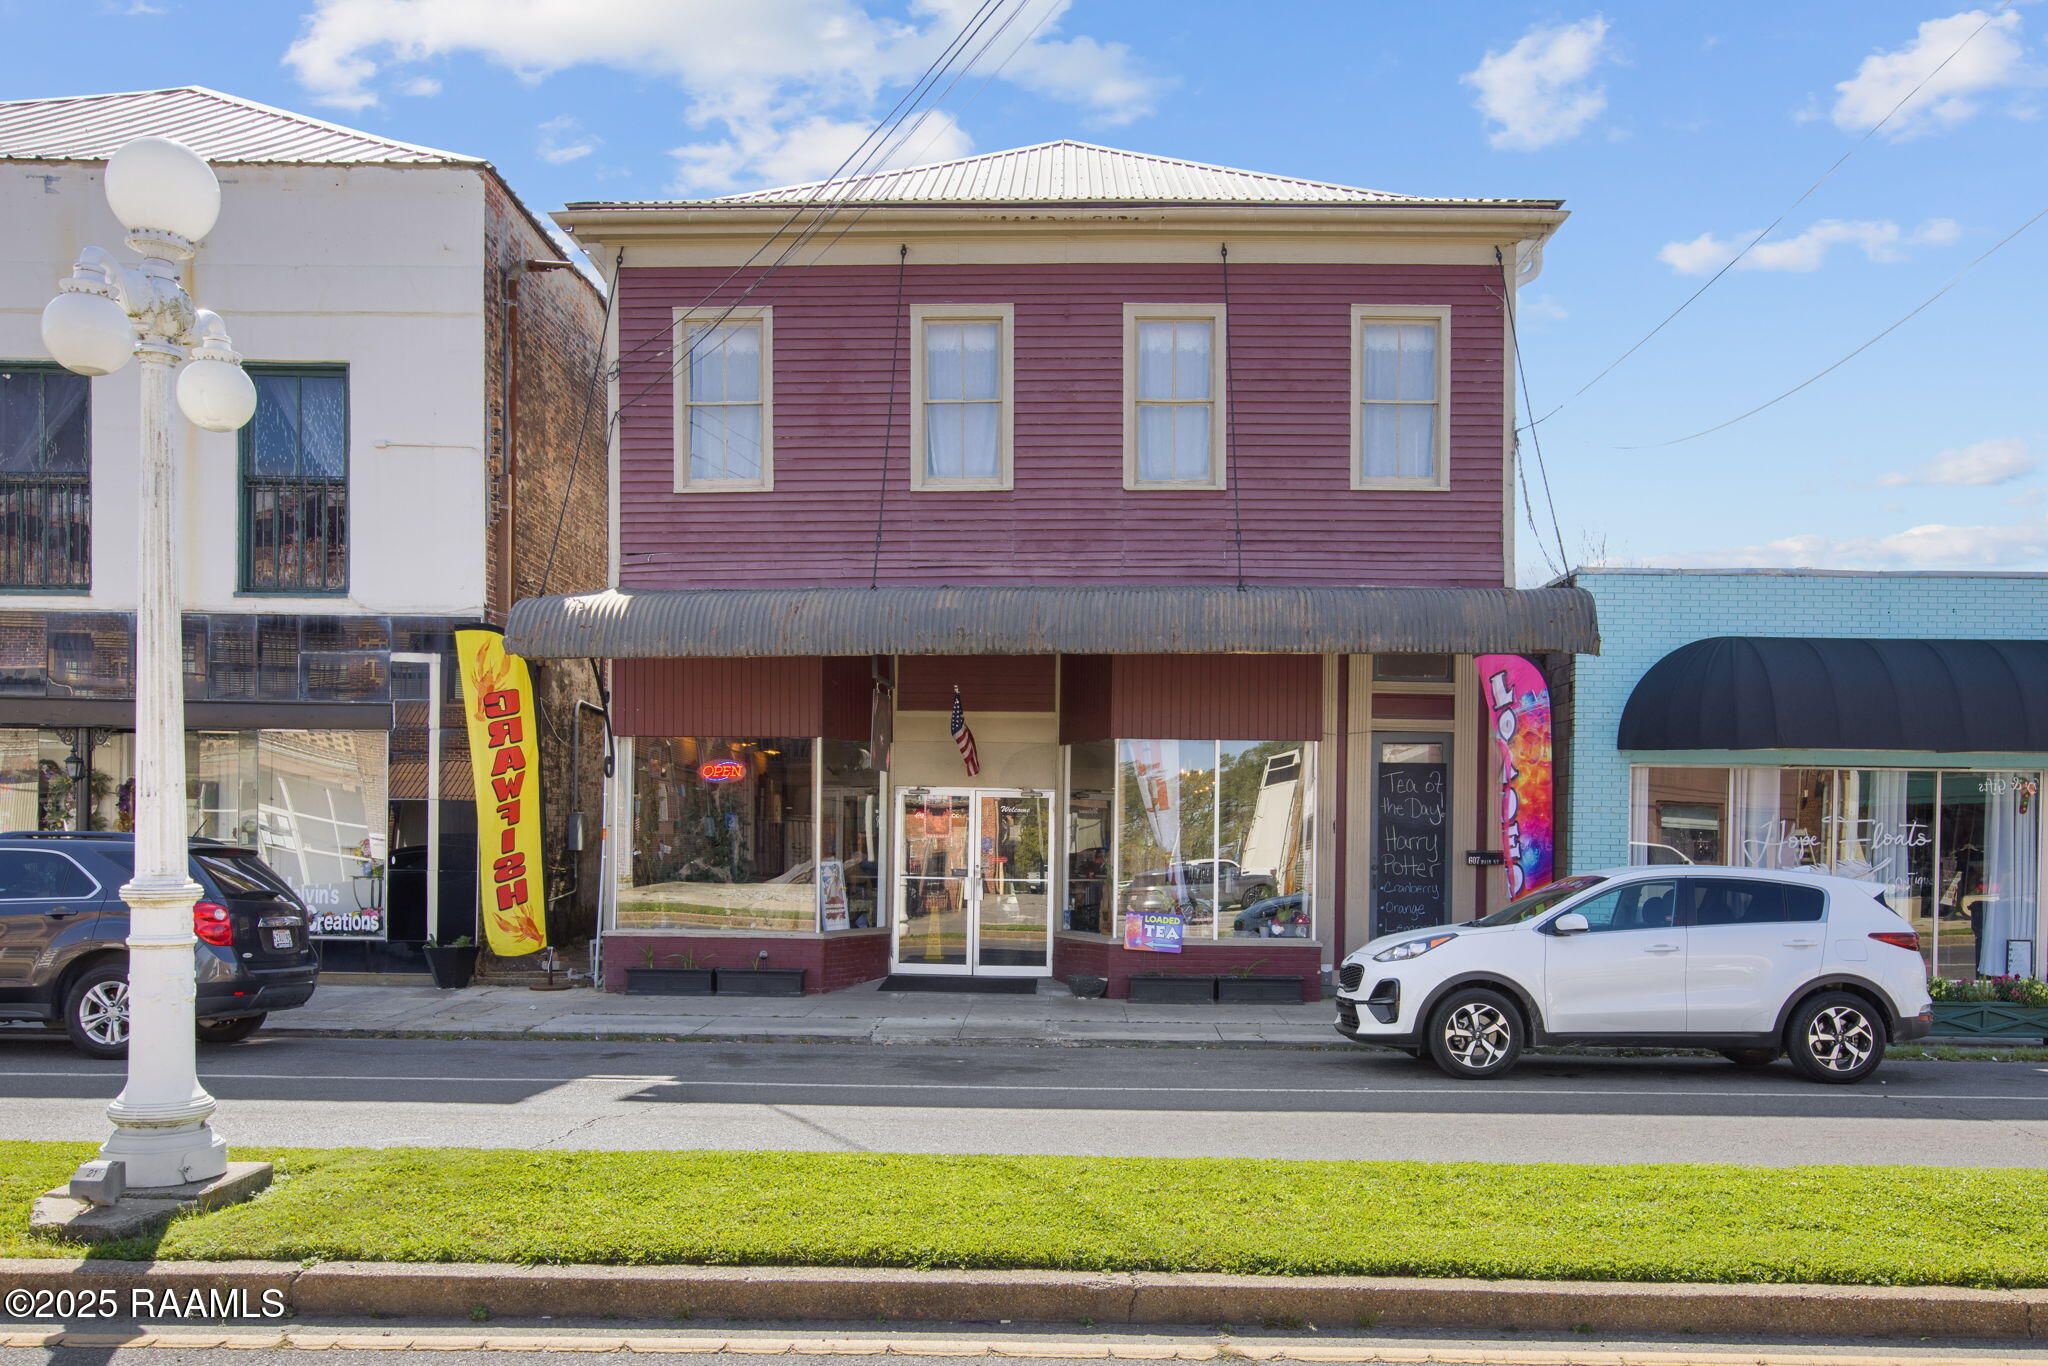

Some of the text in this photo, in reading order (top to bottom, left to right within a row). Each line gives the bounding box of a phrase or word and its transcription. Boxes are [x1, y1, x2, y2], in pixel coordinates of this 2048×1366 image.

[702, 764, 743, 778] OPEN
[1381, 770, 1444, 794] Tea of
[1000, 805, 1031, 814] Welcome
[1380, 797, 1406, 817] the
[1384, 825, 1439, 863] Harry
[1743, 815, 1933, 865] Hope Floats
[1381, 853, 1442, 878] Potter
[1383, 881, 1440, 900] Cranberry
[1144, 915, 1181, 925] LOADED
[1385, 901, 1426, 921] Orange
[1144, 923, 1181, 940] TEA
